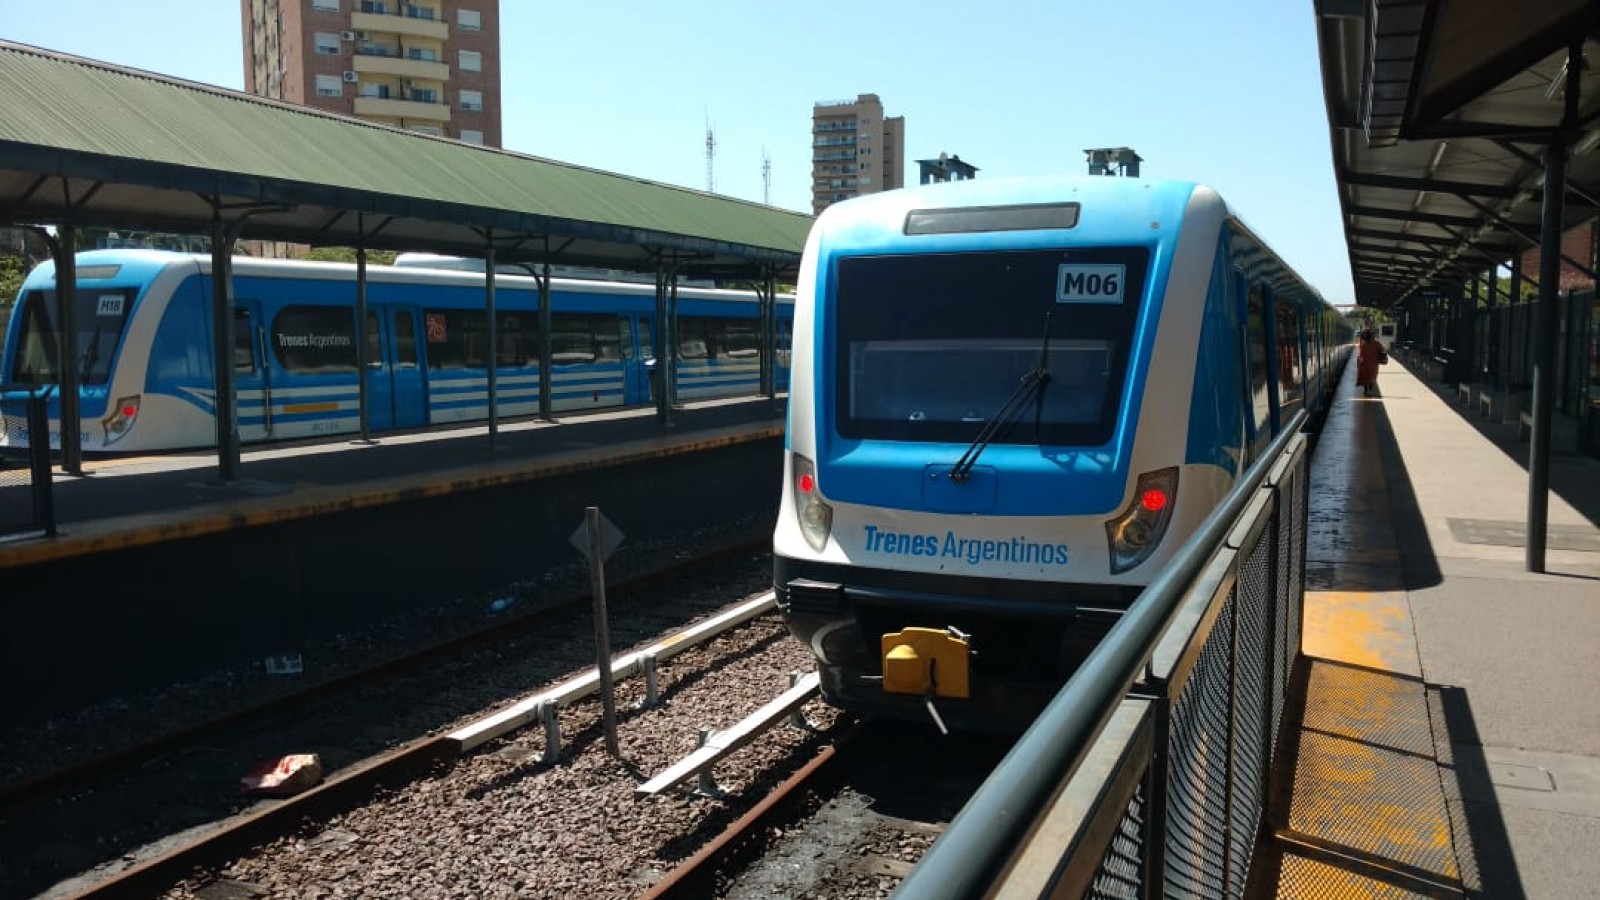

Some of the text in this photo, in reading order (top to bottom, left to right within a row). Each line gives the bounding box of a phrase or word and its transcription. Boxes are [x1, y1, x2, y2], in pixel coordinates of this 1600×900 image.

[1064, 272, 1118, 295] M06
[276, 333, 308, 347] Trenes
[864, 525, 1068, 565] Trenes Argentinos
